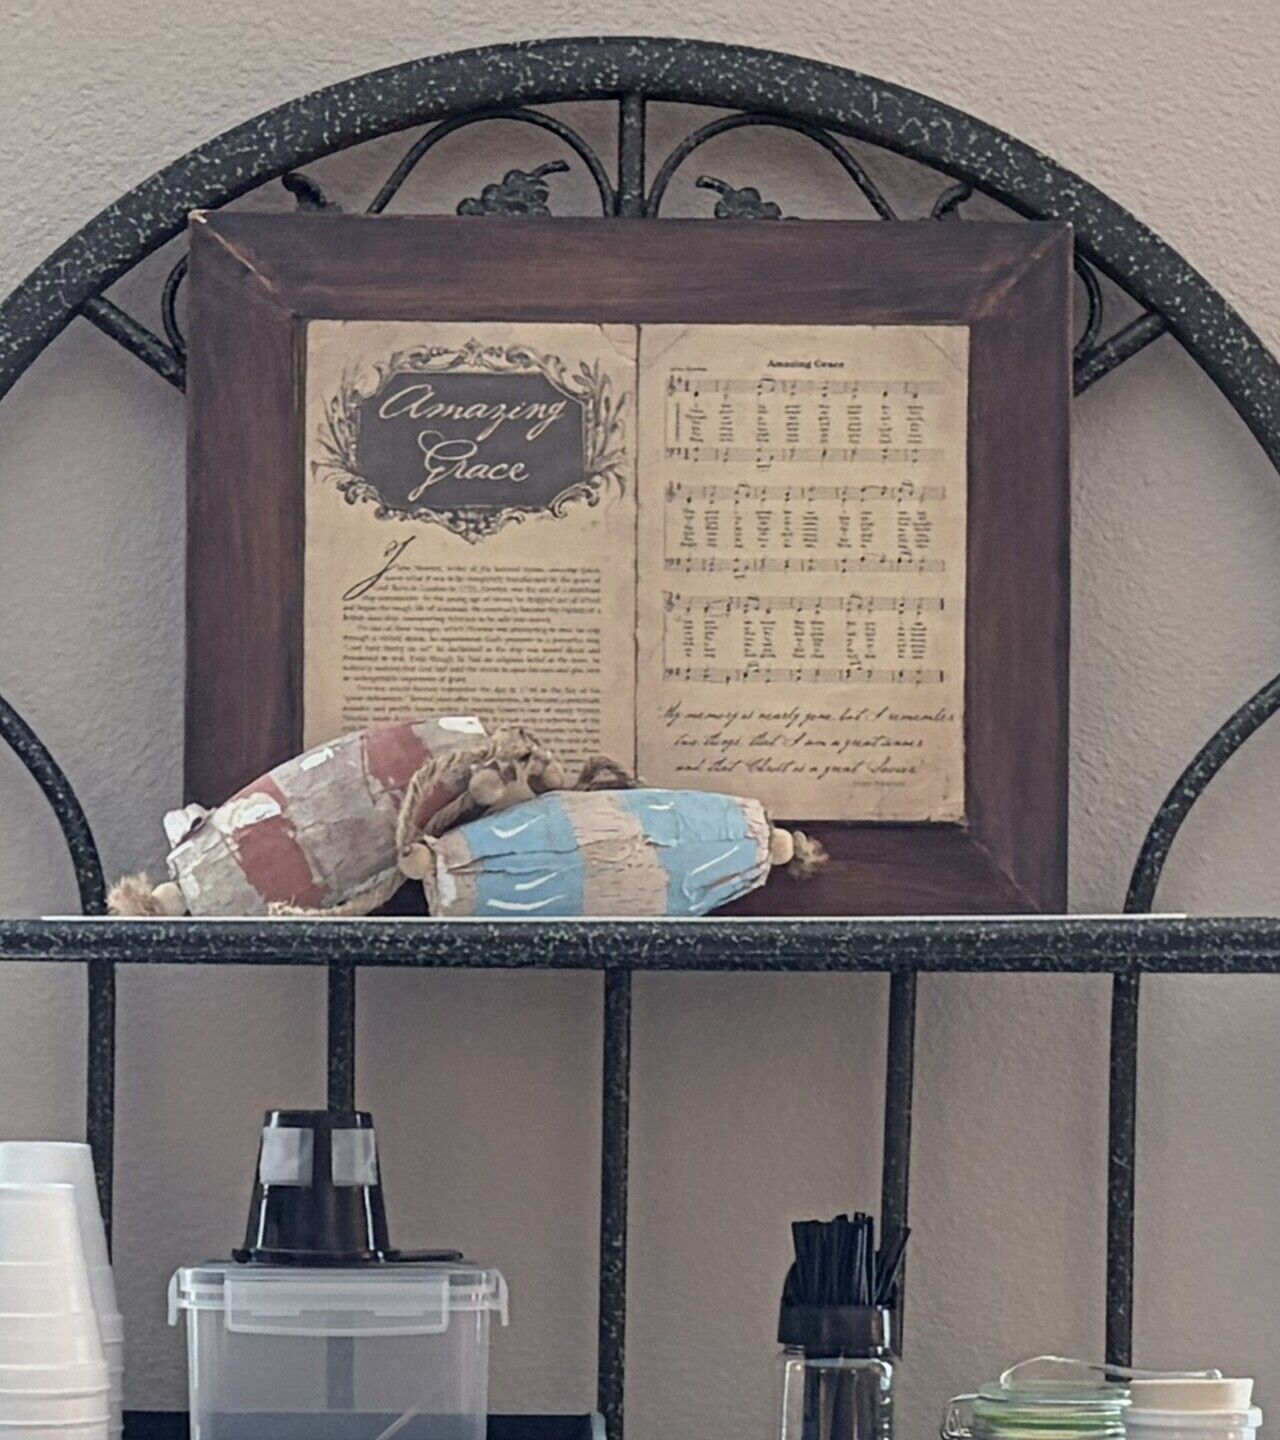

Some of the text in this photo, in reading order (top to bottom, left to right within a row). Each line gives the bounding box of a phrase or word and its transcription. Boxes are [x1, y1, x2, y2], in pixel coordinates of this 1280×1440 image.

[767, 359, 845, 369] Amazing Grace
[379, 384, 567, 441] Amazing
[408, 430, 529, 502] Grace
